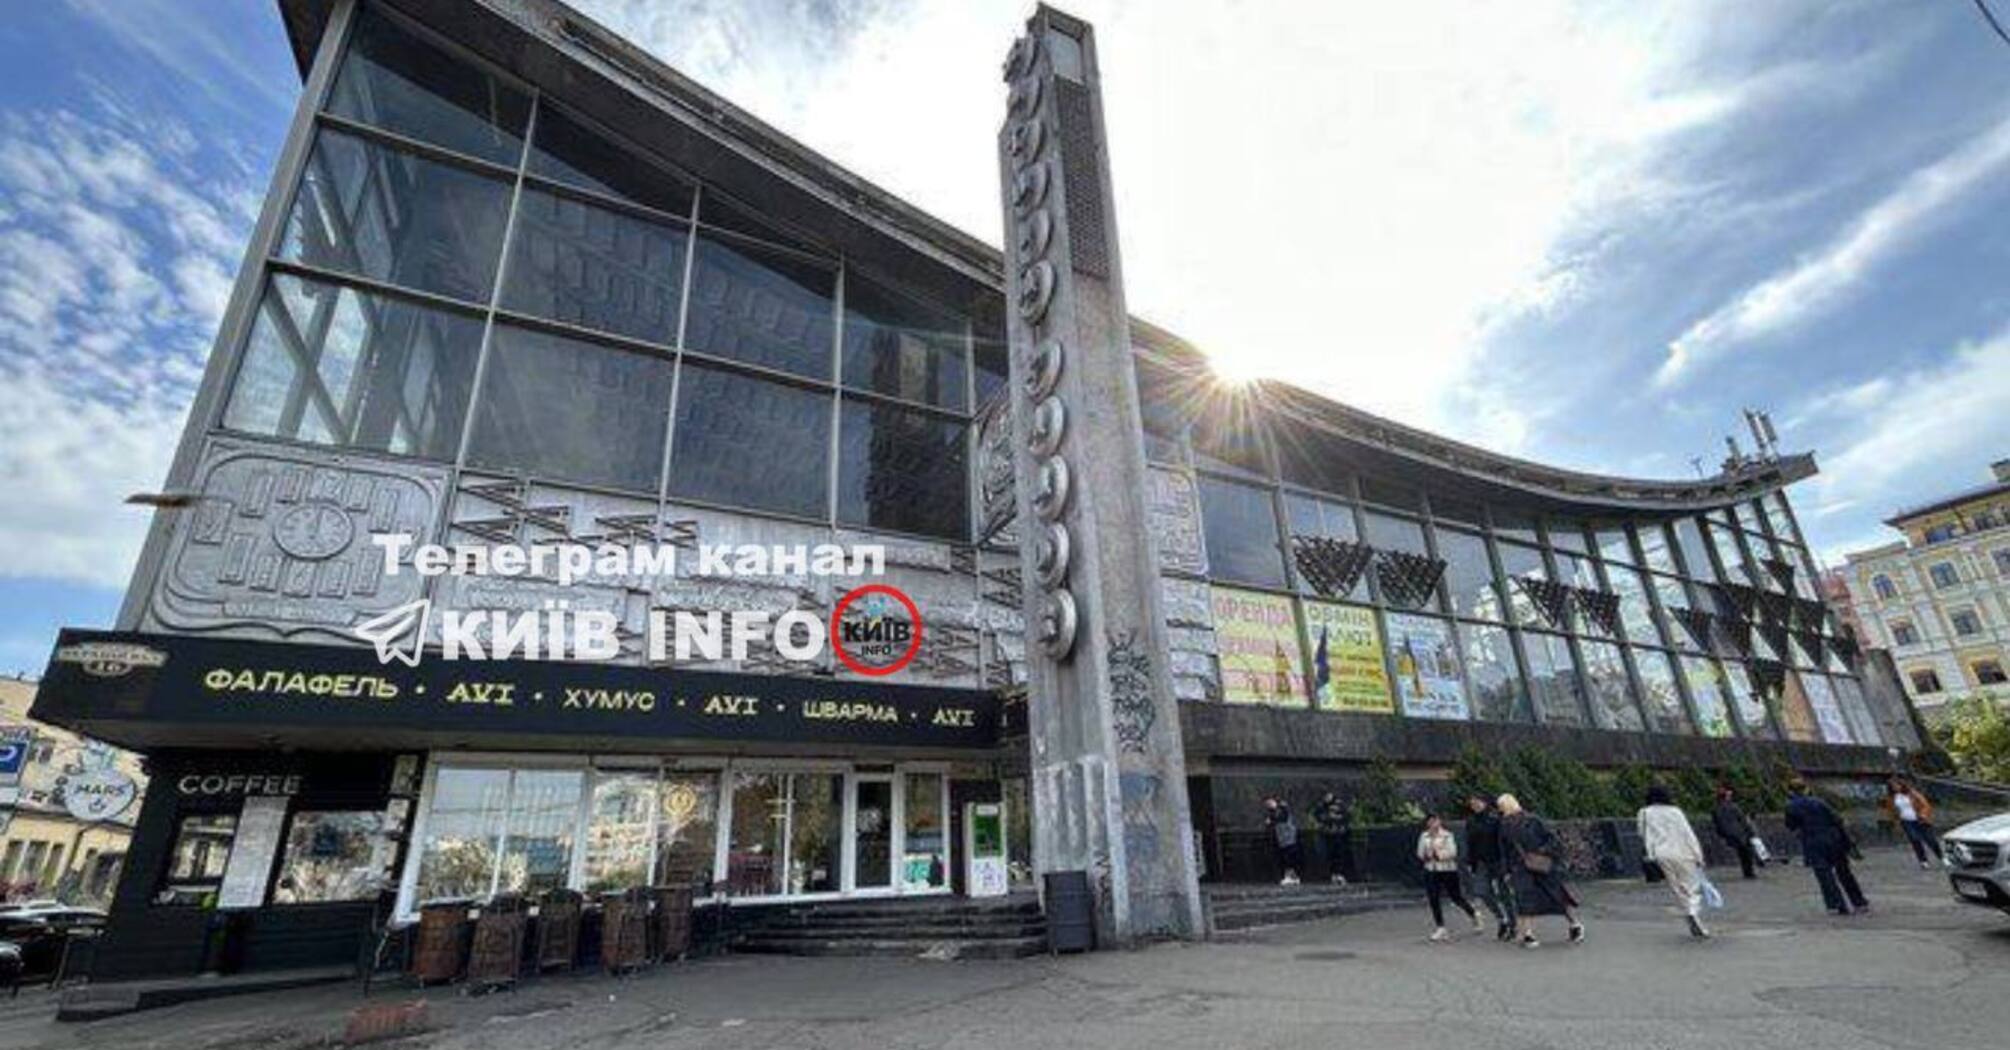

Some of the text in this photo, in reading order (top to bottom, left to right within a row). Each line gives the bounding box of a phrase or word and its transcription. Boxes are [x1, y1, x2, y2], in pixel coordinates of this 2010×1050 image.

[205, 668, 976, 728] ФАЛАФЕЛЬ AVI ХУМУС AVI ШВАРМА AVI
[178, 775, 302, 795] COFFEE
